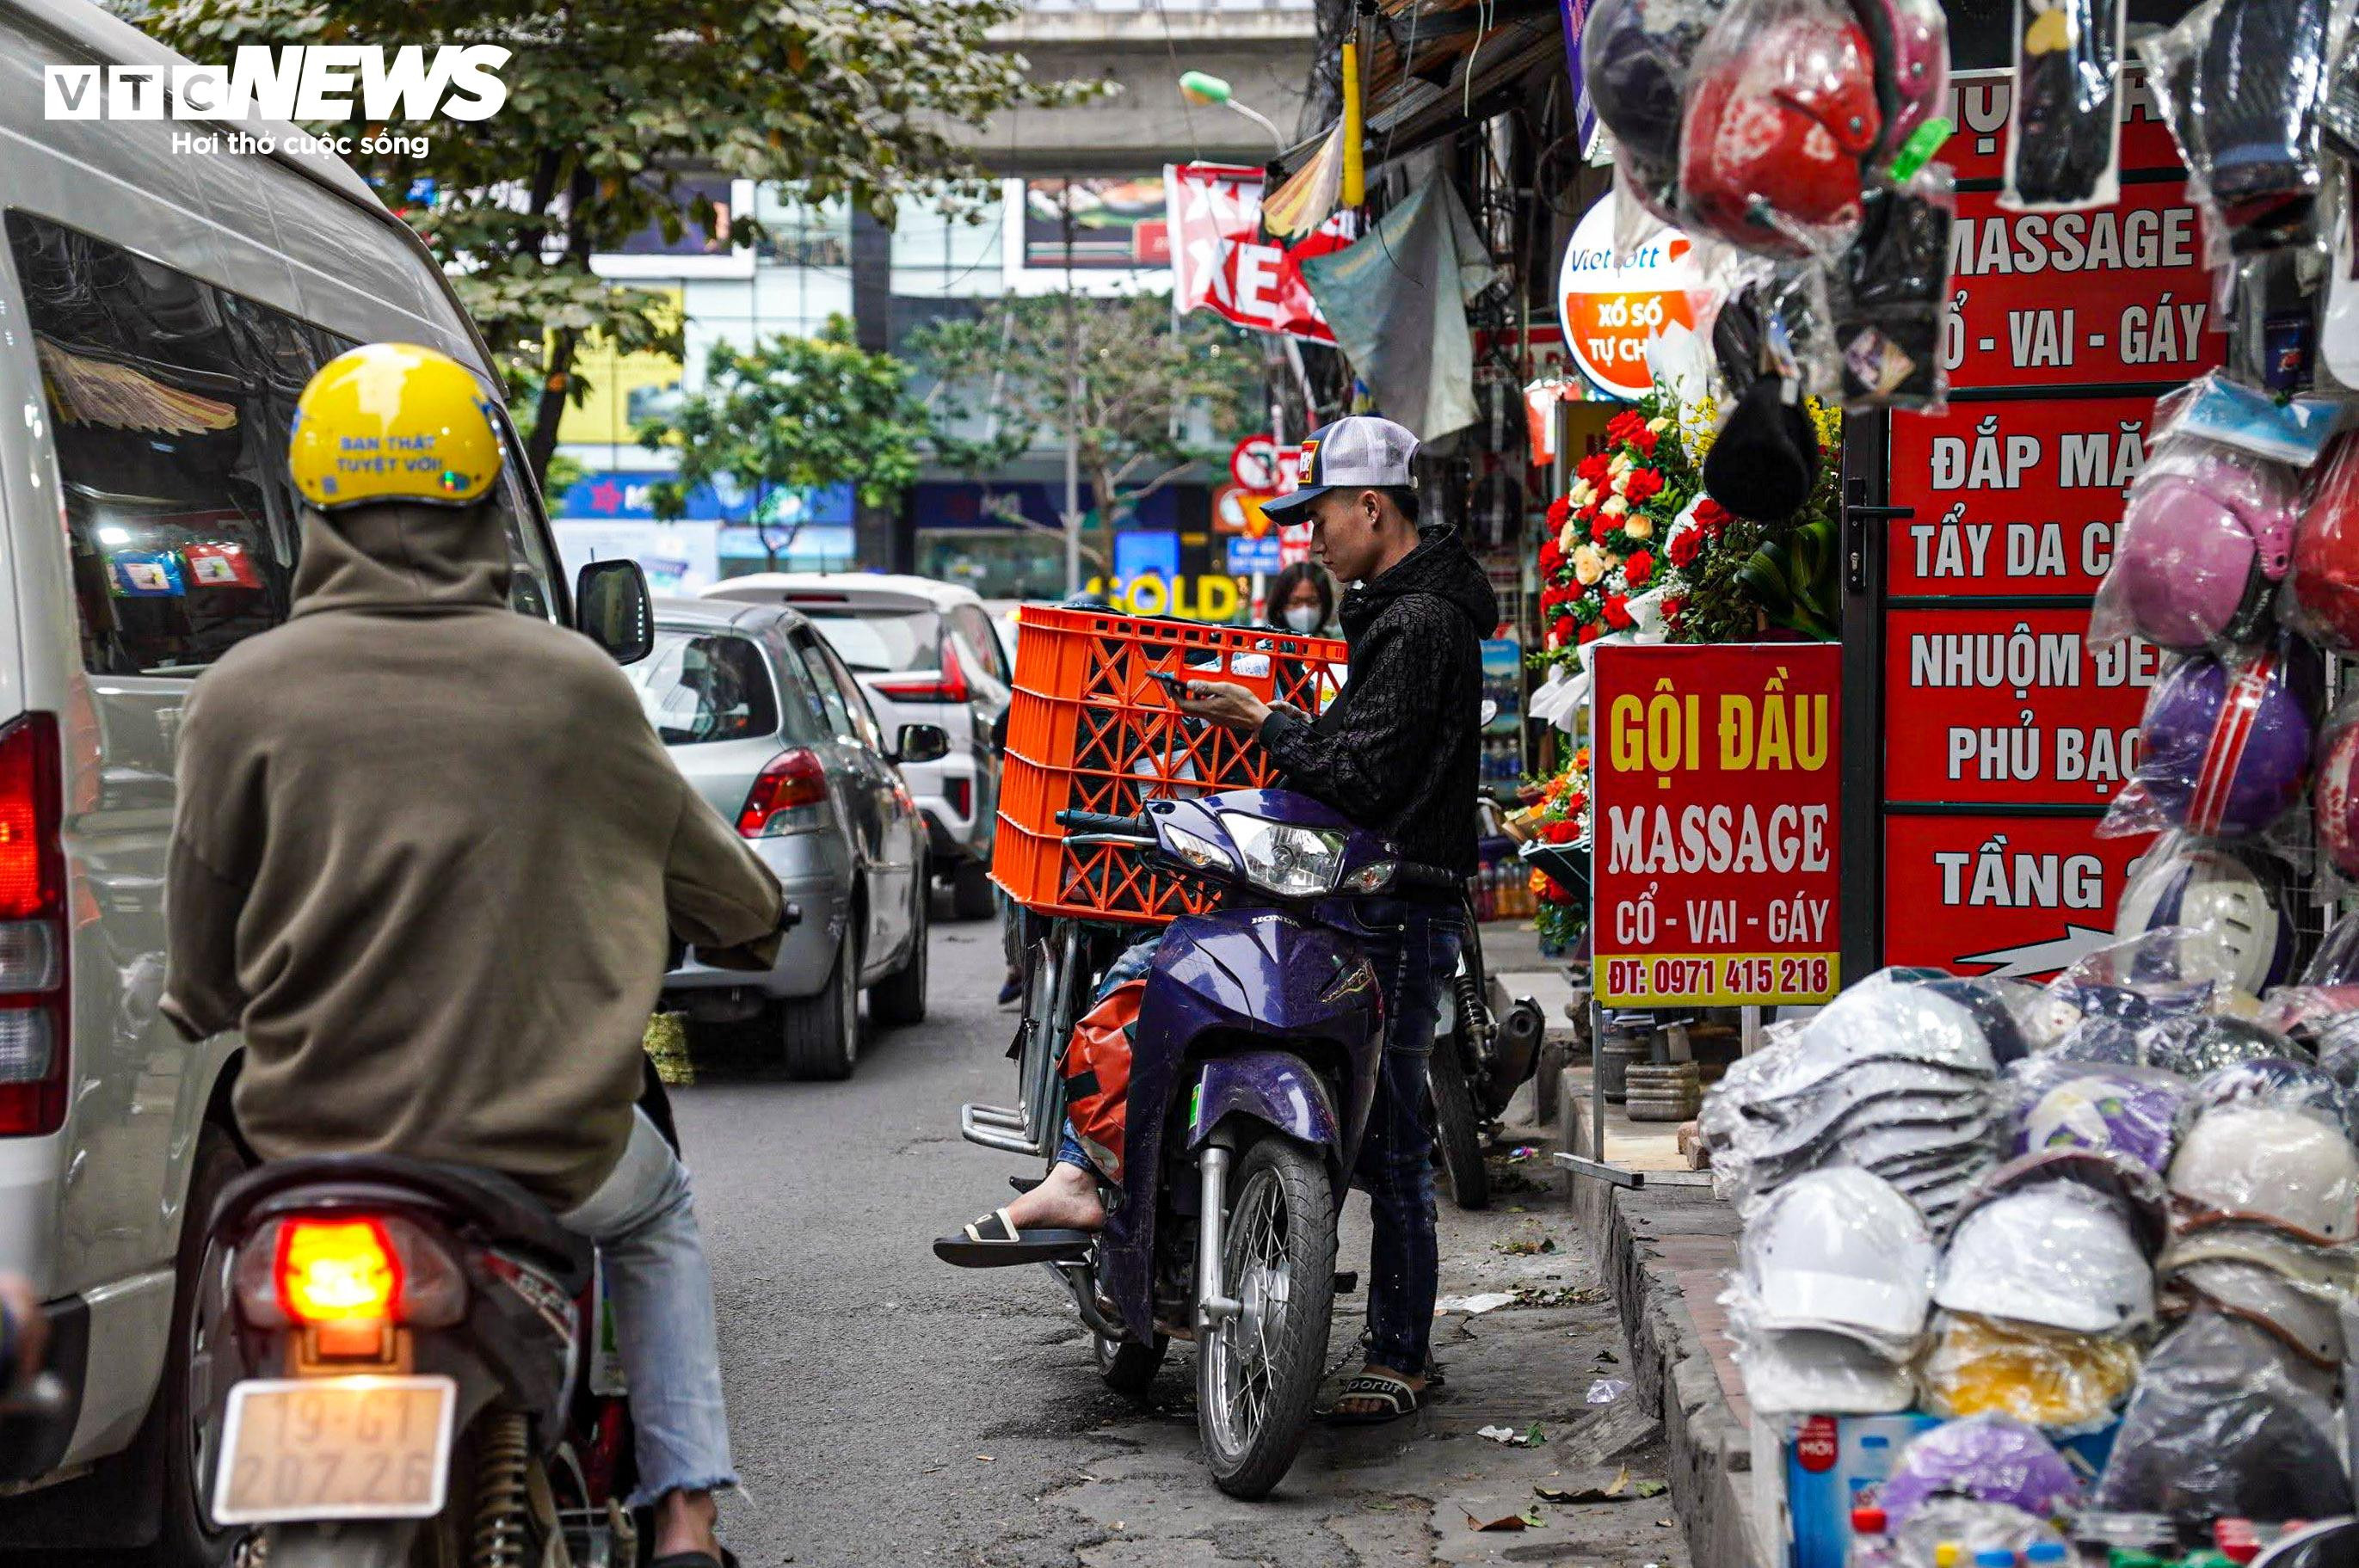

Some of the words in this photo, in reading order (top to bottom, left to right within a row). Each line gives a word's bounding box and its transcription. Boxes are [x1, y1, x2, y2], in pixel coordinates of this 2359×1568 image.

[1188, 237, 1283, 323] XE
[1573, 247, 1660, 272] Vietott
[1943, 290, 1969, 370] Ổ
[2009, 309, 2074, 367] VAI
[2120, 292, 2207, 365] GÁY
[1931, 415, 2042, 489] ĐẮP
[2060, 421, 2146, 499] MẶ
[1910, 501, 1993, 577] TẨY
[2006, 523, 2066, 577] DA
[1911, 622, 2080, 698] NHUỘM
[2096, 637, 2164, 686] ĐE
[1610, 677, 1700, 790] GỘI
[1717, 667, 1829, 772] ĐẦU
[1948, 709, 2040, 780] PHỦ
[1607, 803, 1830, 875] MASSAGE
[1935, 834, 2103, 909] TẦNG
[1251, 914, 1302, 930] HONDA
[1616, 881, 1659, 945] CỔ
[1686, 900, 1736, 944] VAI
[1768, 890, 1830, 944] GÁY
[1607, 959, 1647, 996] ĐT:
[1654, 958, 1715, 995] 0971
[1724, 957, 1775, 993] 415
[1780, 956, 1829, 993] 218
